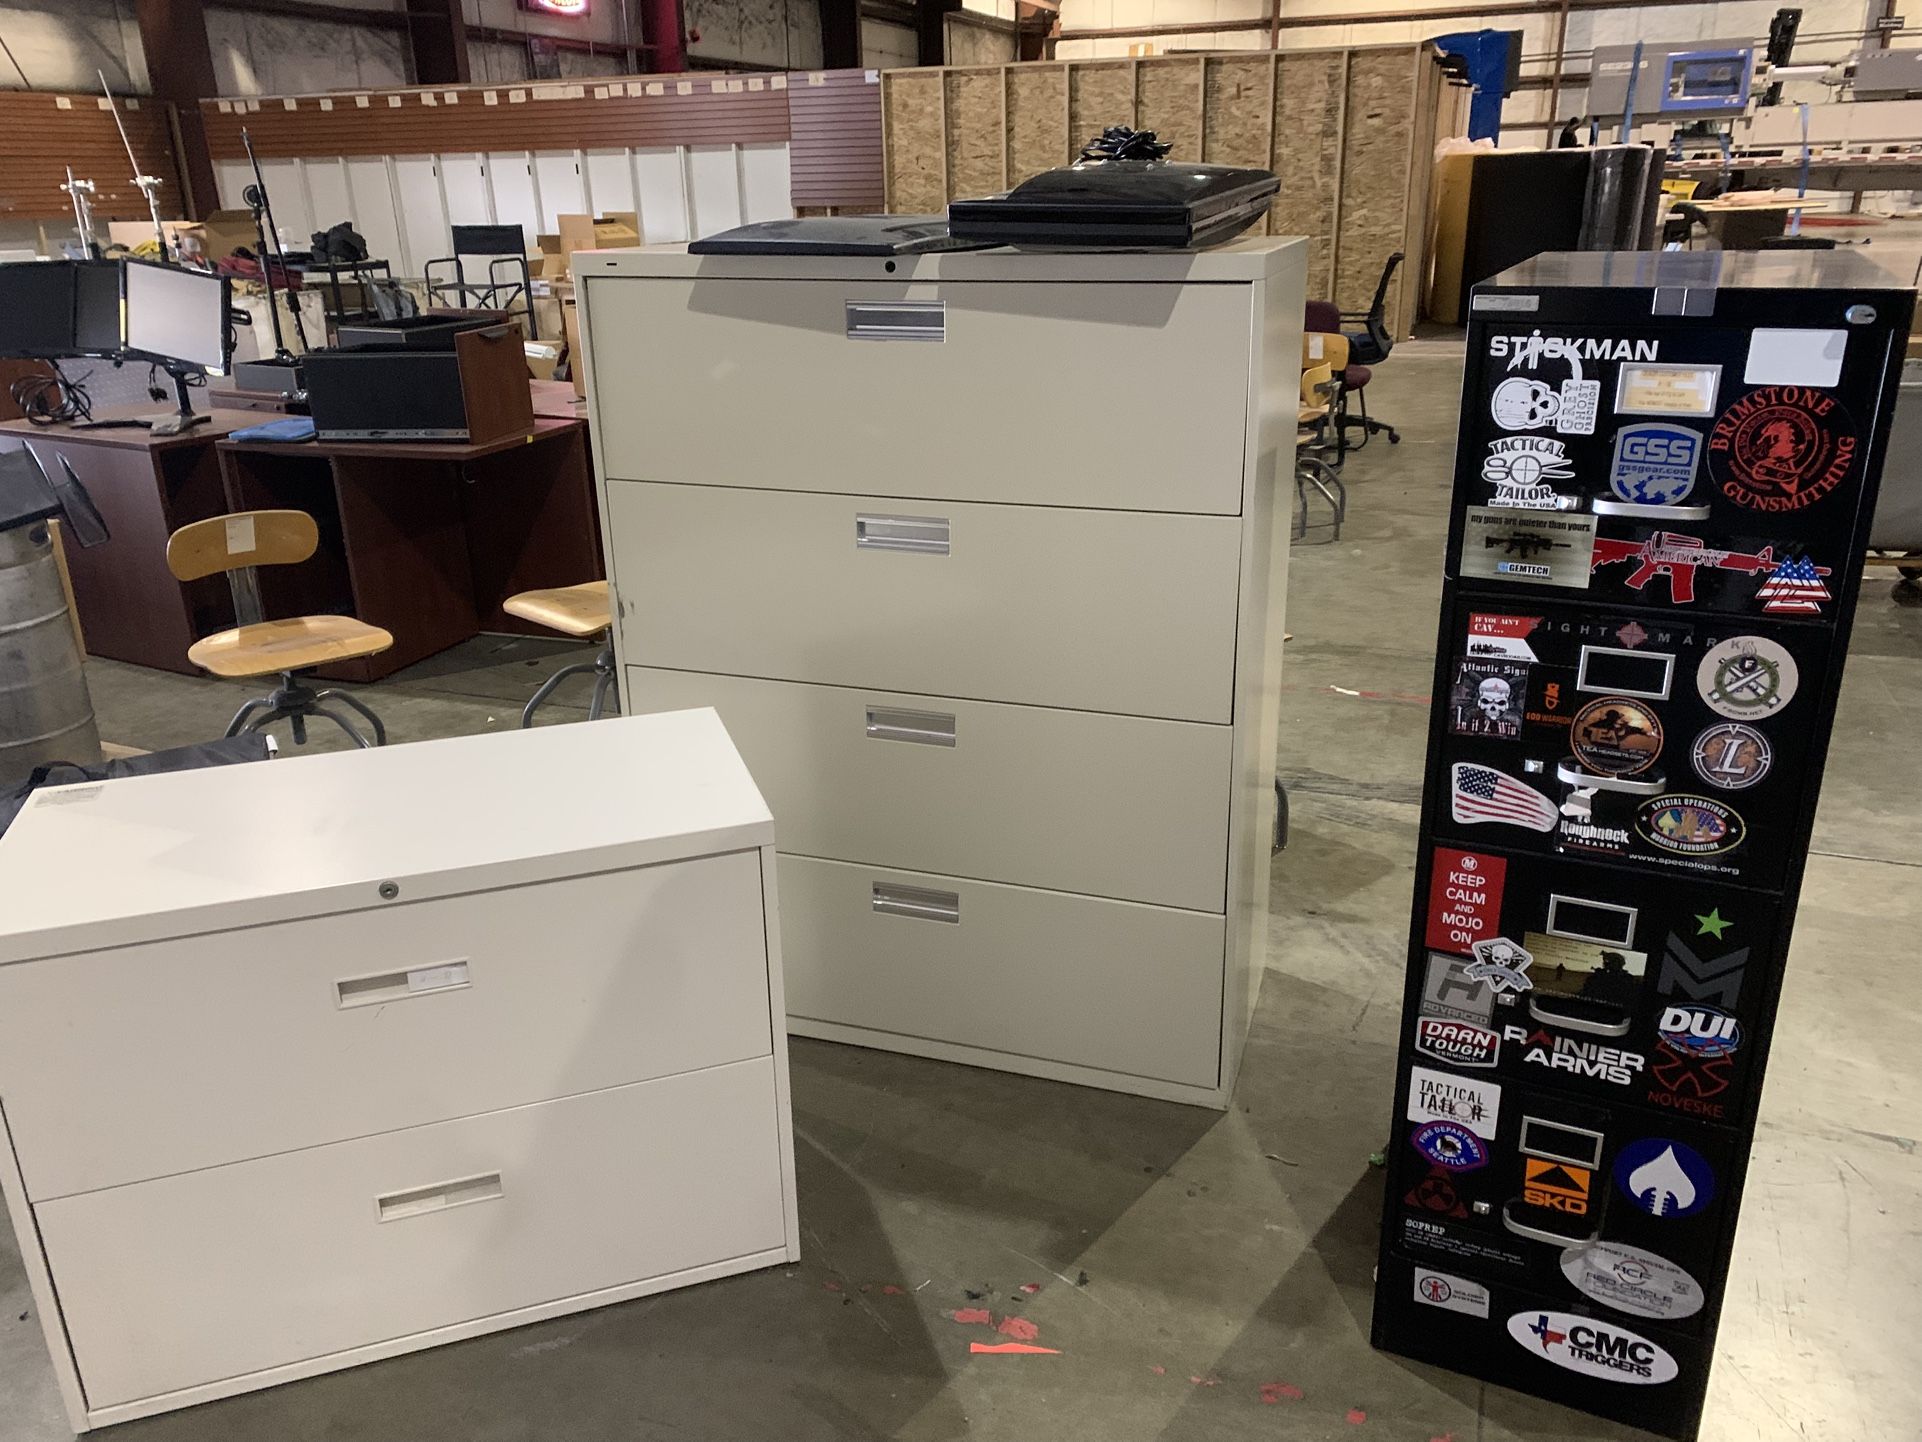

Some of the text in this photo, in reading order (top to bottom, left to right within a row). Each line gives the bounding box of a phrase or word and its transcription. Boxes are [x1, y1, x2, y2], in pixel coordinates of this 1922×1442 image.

[1560, 383, 1579, 431] GREY
[1573, 383, 1591, 431] GHOST
[1711, 385, 1836, 452] BRIMSTONE
[1489, 437, 1565, 458] TACTICAL
[1621, 436, 1693, 466] GSS
[1617, 464, 1692, 476] gssgear.com
[1723, 436, 1857, 513] GUNSMITHING
[1489, 499, 1558, 509] Made In The USA
[1470, 514, 1591, 533] my guns are quieter than yours
[1507, 563, 1550, 575] GEMTECH
[1482, 616, 1498, 624] YOU
[1500, 618, 1520, 626] AIN'T
[1529, 620, 1741, 650] SIGHT MARK
[1456, 663, 1529, 684] Atlantic Signa
[1456, 706, 1467, 730] In
[1483, 719, 1491, 733] 2
[1498, 721, 1517, 736] Win
[1526, 711, 1541, 721] EOD
[1651, 797, 1730, 819] SPECIAL OPERATIONS
[1560, 819, 1630, 845] Roughneck
[1567, 836, 1620, 850] FIREARMS
[1650, 831, 1720, 853] WARRIOR FOUNDATION
[1628, 852, 1741, 876] www.specialops.org
[1449, 871, 1486, 888] KEEP
[1445, 887, 1487, 906] CALM
[1454, 903, 1475, 914] AND
[1441, 911, 1484, 931] MOJO
[1450, 929, 1472, 944] ON
[1422, 1000, 1489, 1025] ADVANCED
[1658, 1006, 1738, 1041] DUI
[1425, 1021, 1492, 1047] DARN
[1424, 1035, 1488, 1059] TOUGH
[1434, 1048, 1476, 1063] VERMONT
[1503, 1023, 1646, 1072] RAINIER
[1522, 1047, 1632, 1086] ARMS
[1419, 1079, 1484, 1106] TACTICAL
[1647, 1089, 1725, 1119] NOVESKE
[1419, 1091, 1484, 1122] TAILOR
[1418, 1125, 1481, 1159] FIRE DEPARTMENT
[1427, 1147, 1468, 1166] SEATTLE
[1523, 1188, 1588, 1216] SKD
[1568, 1325, 1656, 1365] CMC
[1567, 1344, 1653, 1378] TRIGGERS
